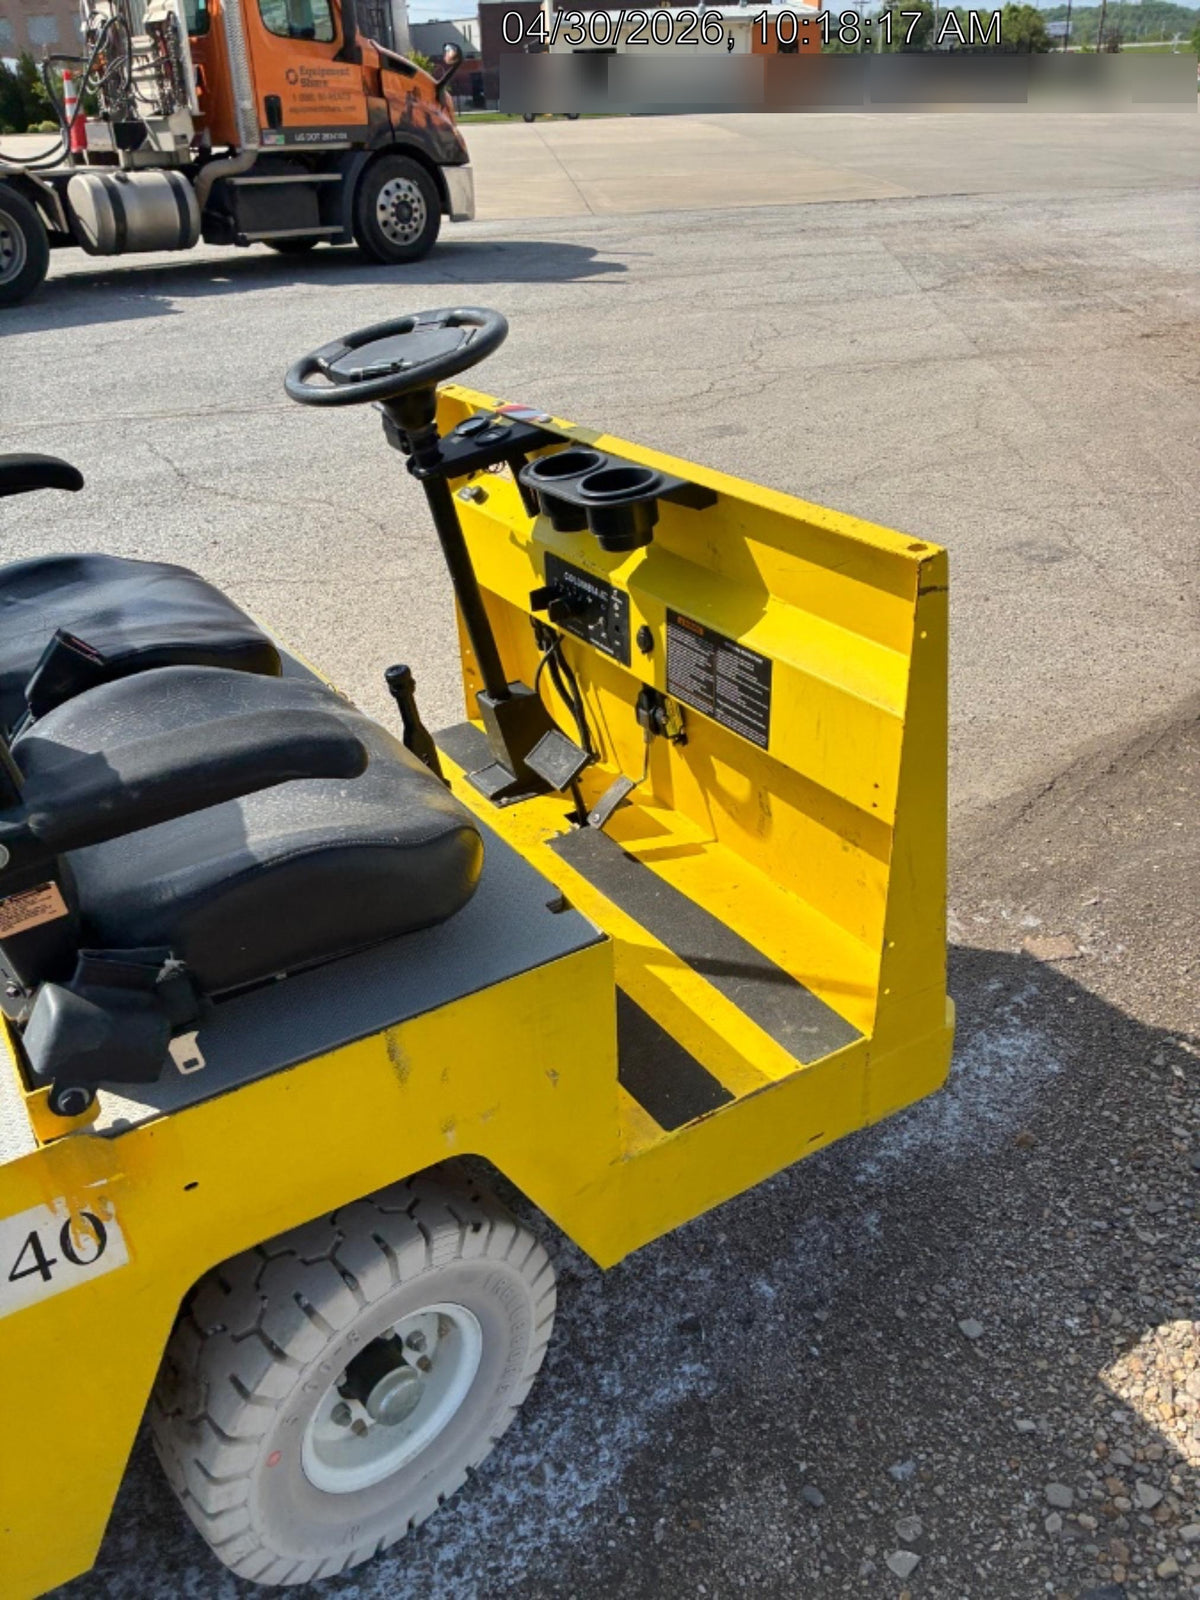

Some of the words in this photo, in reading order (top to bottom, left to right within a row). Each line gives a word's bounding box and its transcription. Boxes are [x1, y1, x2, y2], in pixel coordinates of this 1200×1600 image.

[300, 66, 349, 77] Equipment
[301, 78, 327, 87] Share
[8, 1212, 107, 1282] 40
